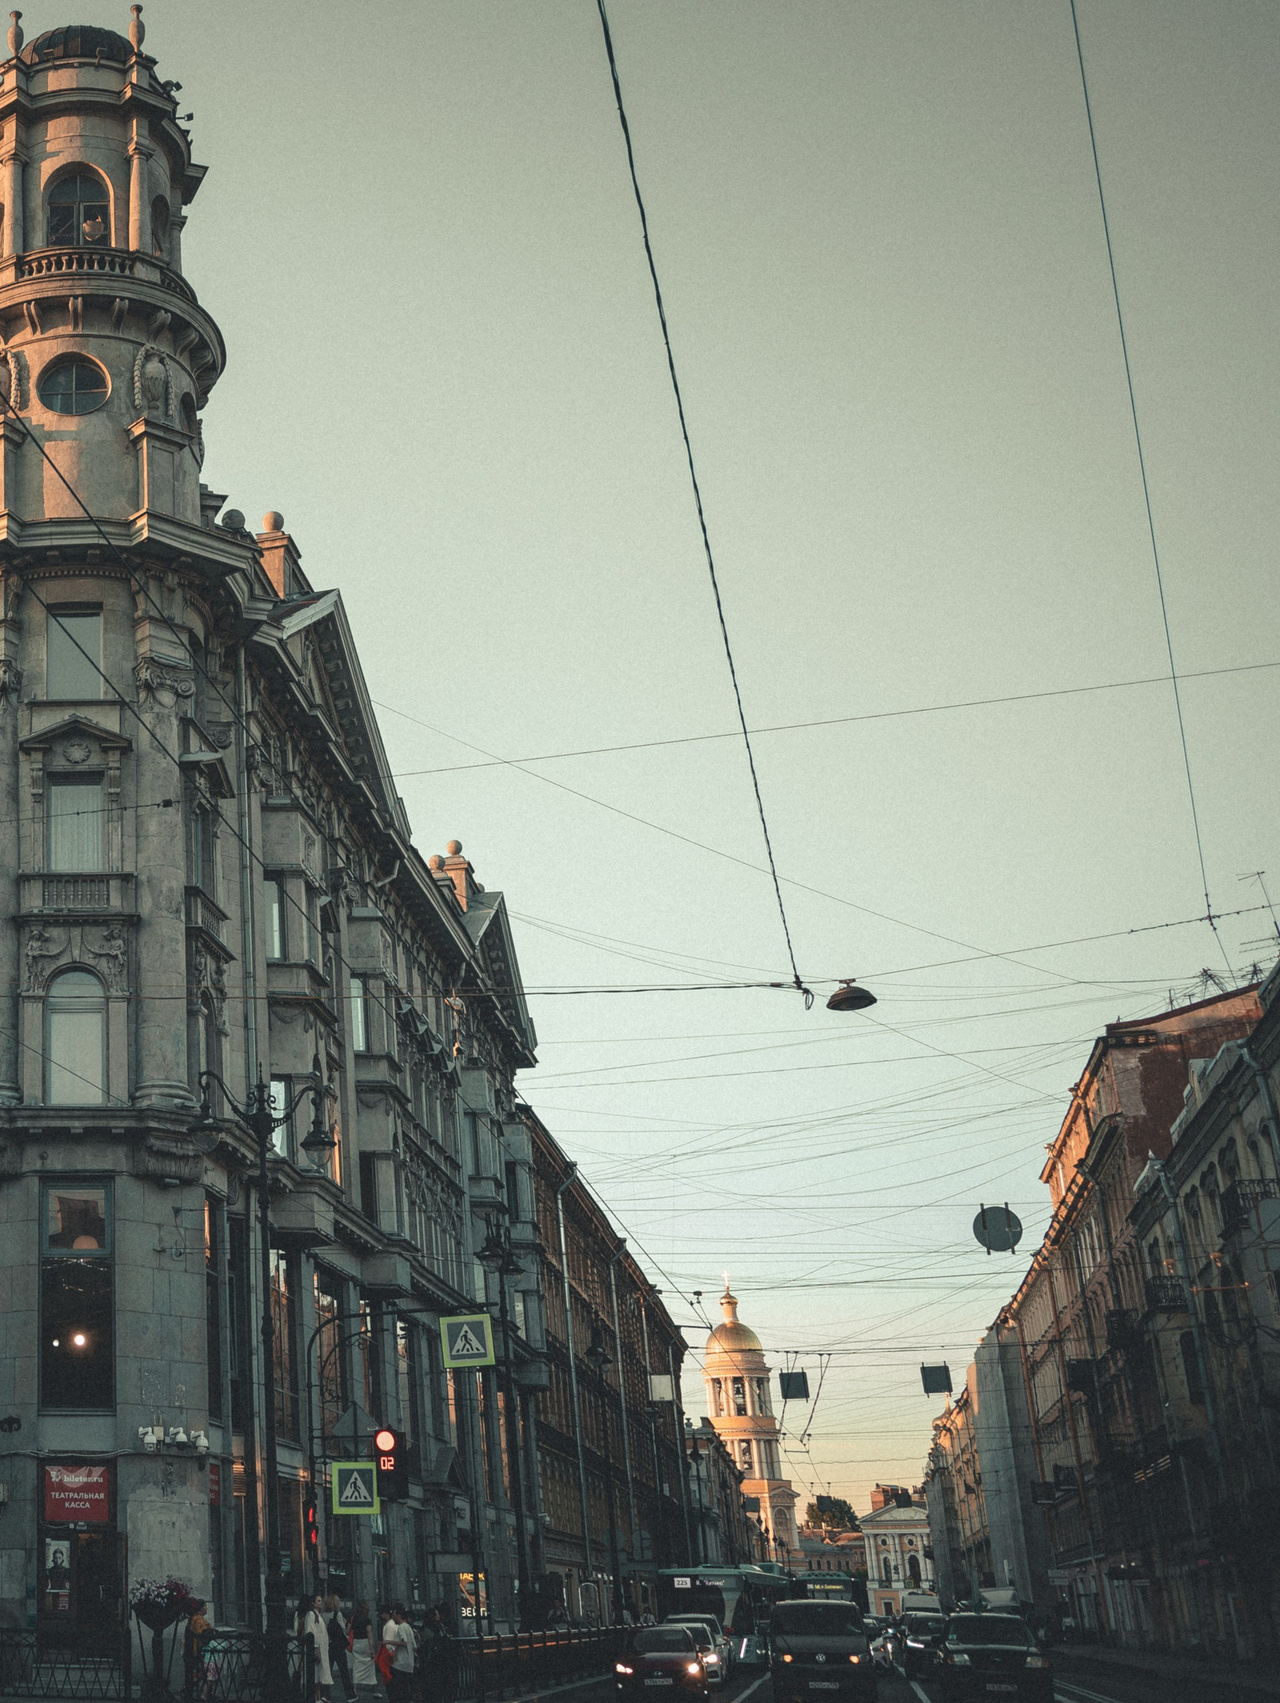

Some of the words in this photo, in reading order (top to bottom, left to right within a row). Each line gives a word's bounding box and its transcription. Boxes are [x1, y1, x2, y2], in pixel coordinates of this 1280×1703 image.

[380, 1456, 395, 1470] 02
[63, 1474, 104, 1483] bileter.ru
[50, 1491, 105, 1499] ТЕАТРАЛЬНАЯ
